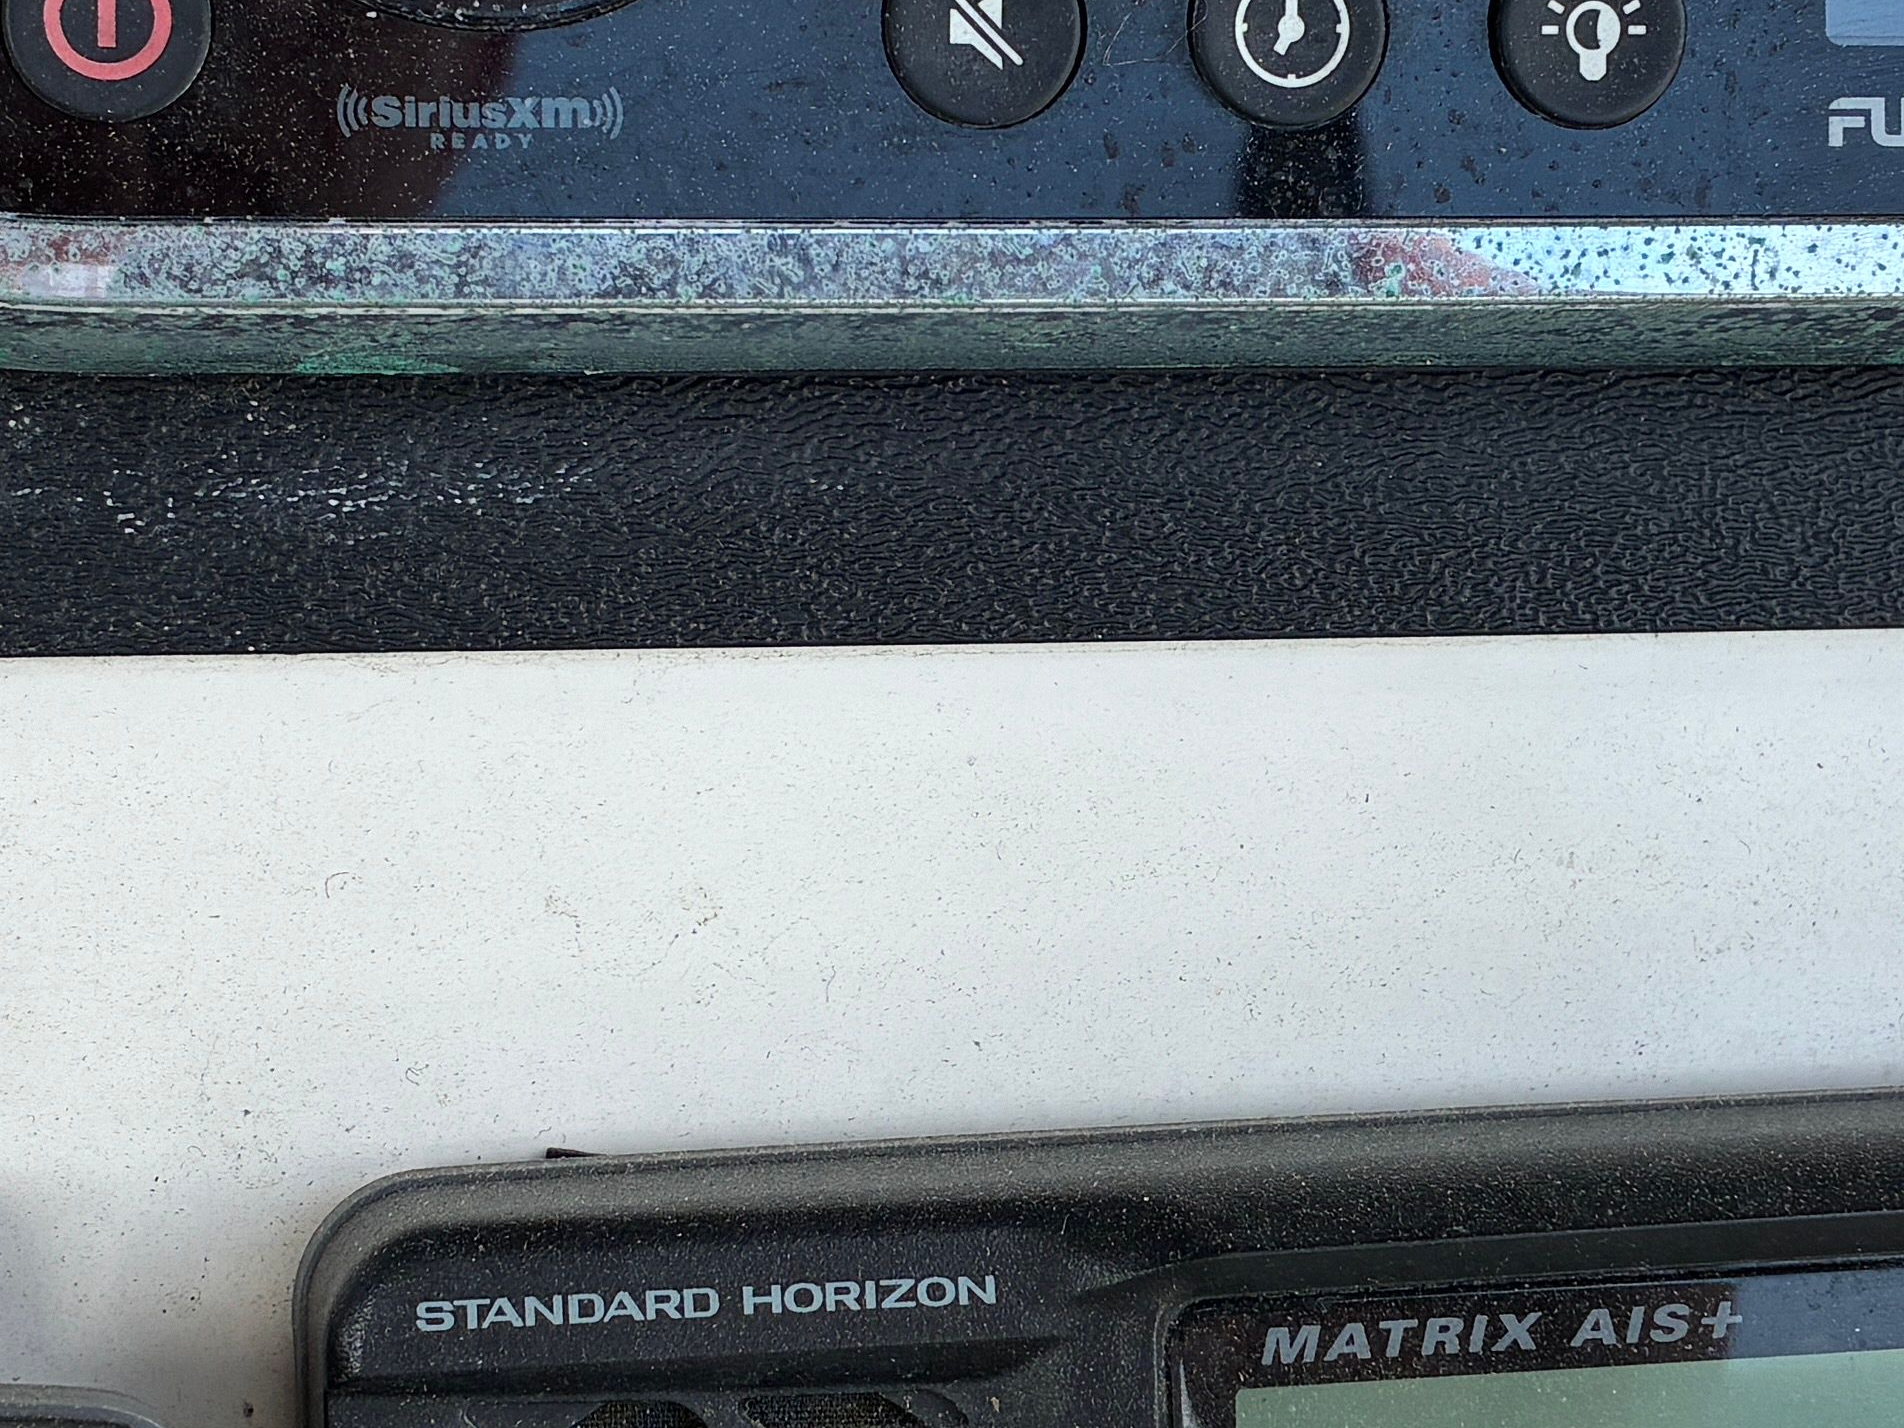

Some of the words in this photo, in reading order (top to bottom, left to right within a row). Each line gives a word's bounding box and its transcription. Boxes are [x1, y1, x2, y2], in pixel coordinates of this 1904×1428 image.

[430, 133, 533, 149] READY
[415, 1286, 720, 1333] STANDARD
[742, 1274, 997, 1317] HORIZON
[1261, 1311, 1538, 1367] MATRIX
[1571, 1299, 1743, 1350] AIS+
